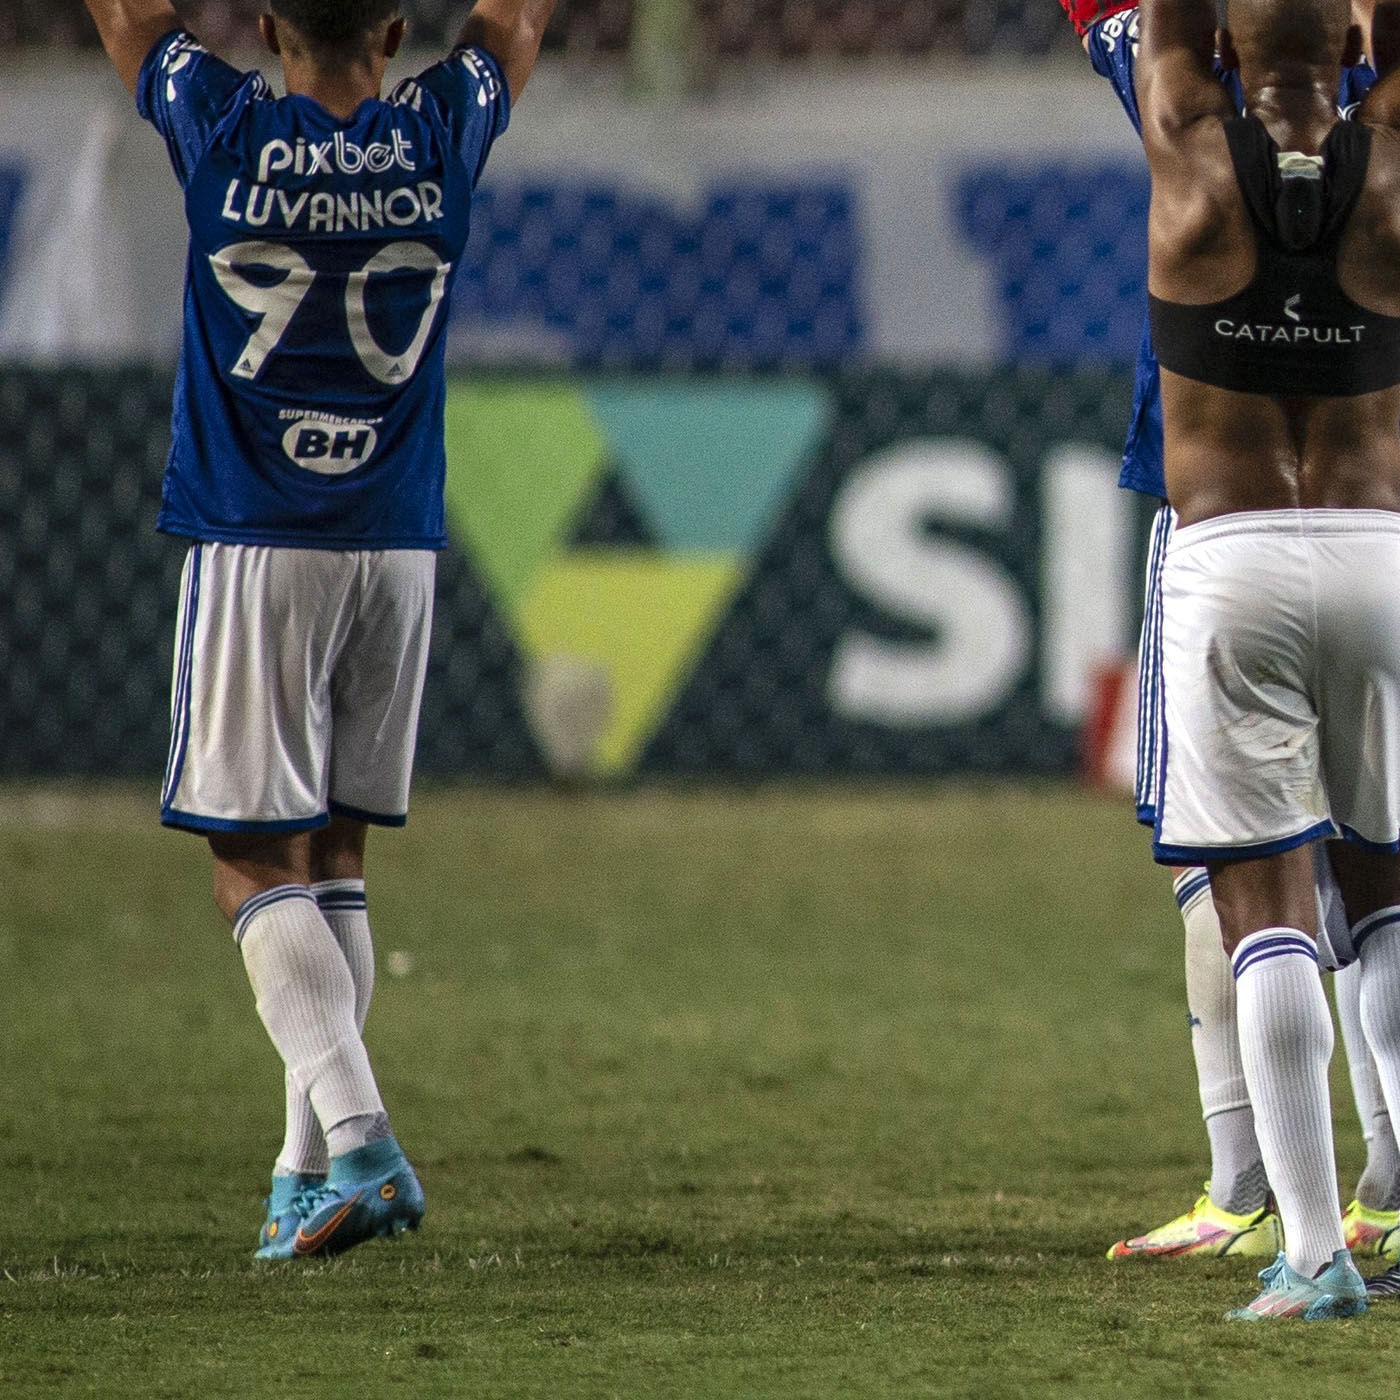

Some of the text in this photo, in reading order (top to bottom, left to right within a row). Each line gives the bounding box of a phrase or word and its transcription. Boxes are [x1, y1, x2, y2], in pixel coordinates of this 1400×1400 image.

[258, 129, 416, 183] pixbet
[222, 178, 445, 232] LUVANNOR
[208, 241, 452, 385] 90
[1214, 319, 1367, 344] CATAPULT
[294, 428, 370, 460] BH
